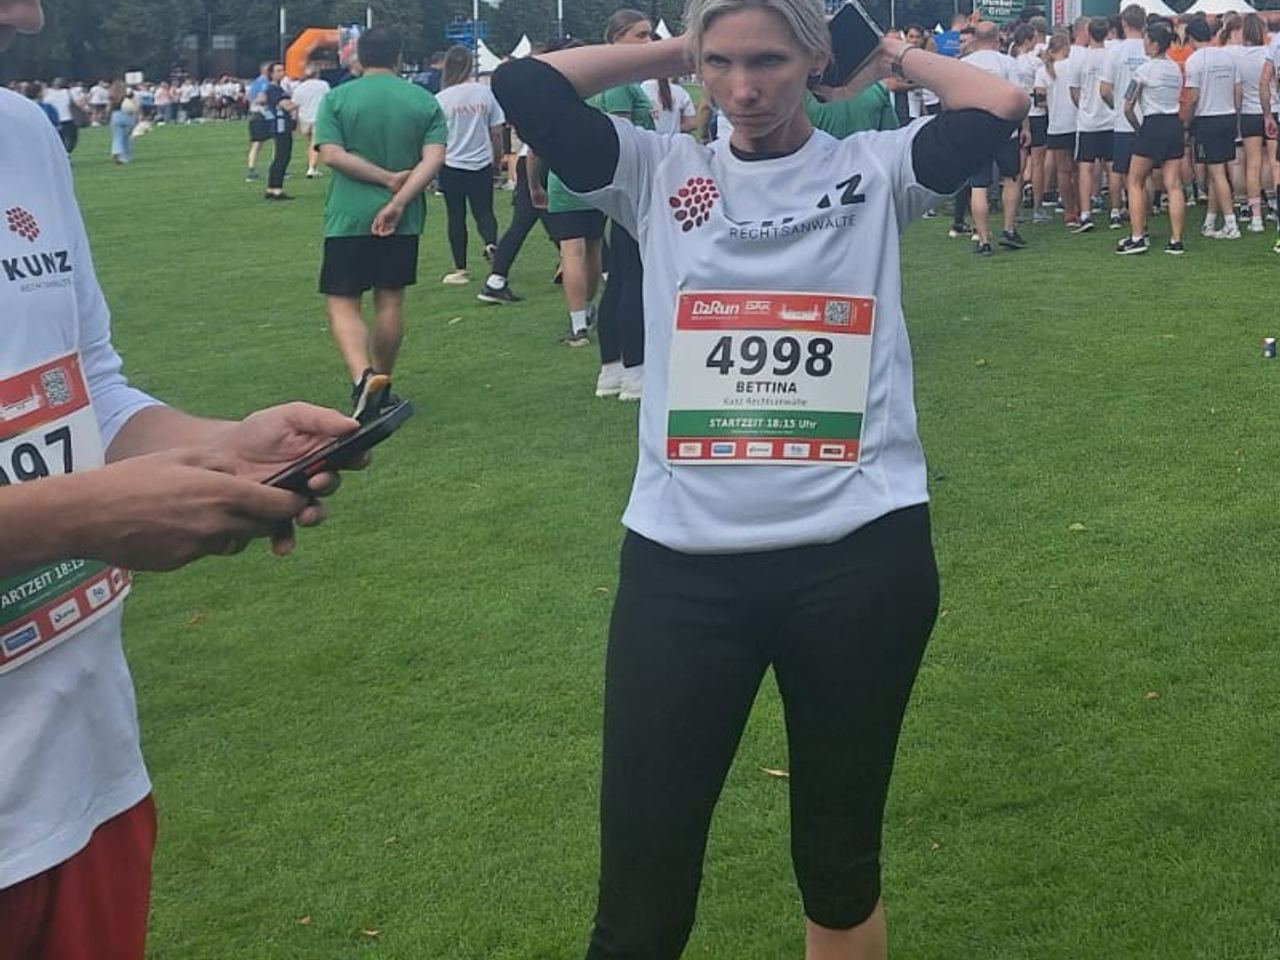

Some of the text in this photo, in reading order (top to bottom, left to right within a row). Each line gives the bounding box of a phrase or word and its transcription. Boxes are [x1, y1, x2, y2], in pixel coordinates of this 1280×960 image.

[2, 250, 72, 281] KUNZ
[706, 336, 833, 377] 4998
[736, 381, 798, 393] BETTINA
[709, 418, 818, 429] STARTZEIT 18:15 Uhr
[0, 572, 52, 608] ARTZEIT
